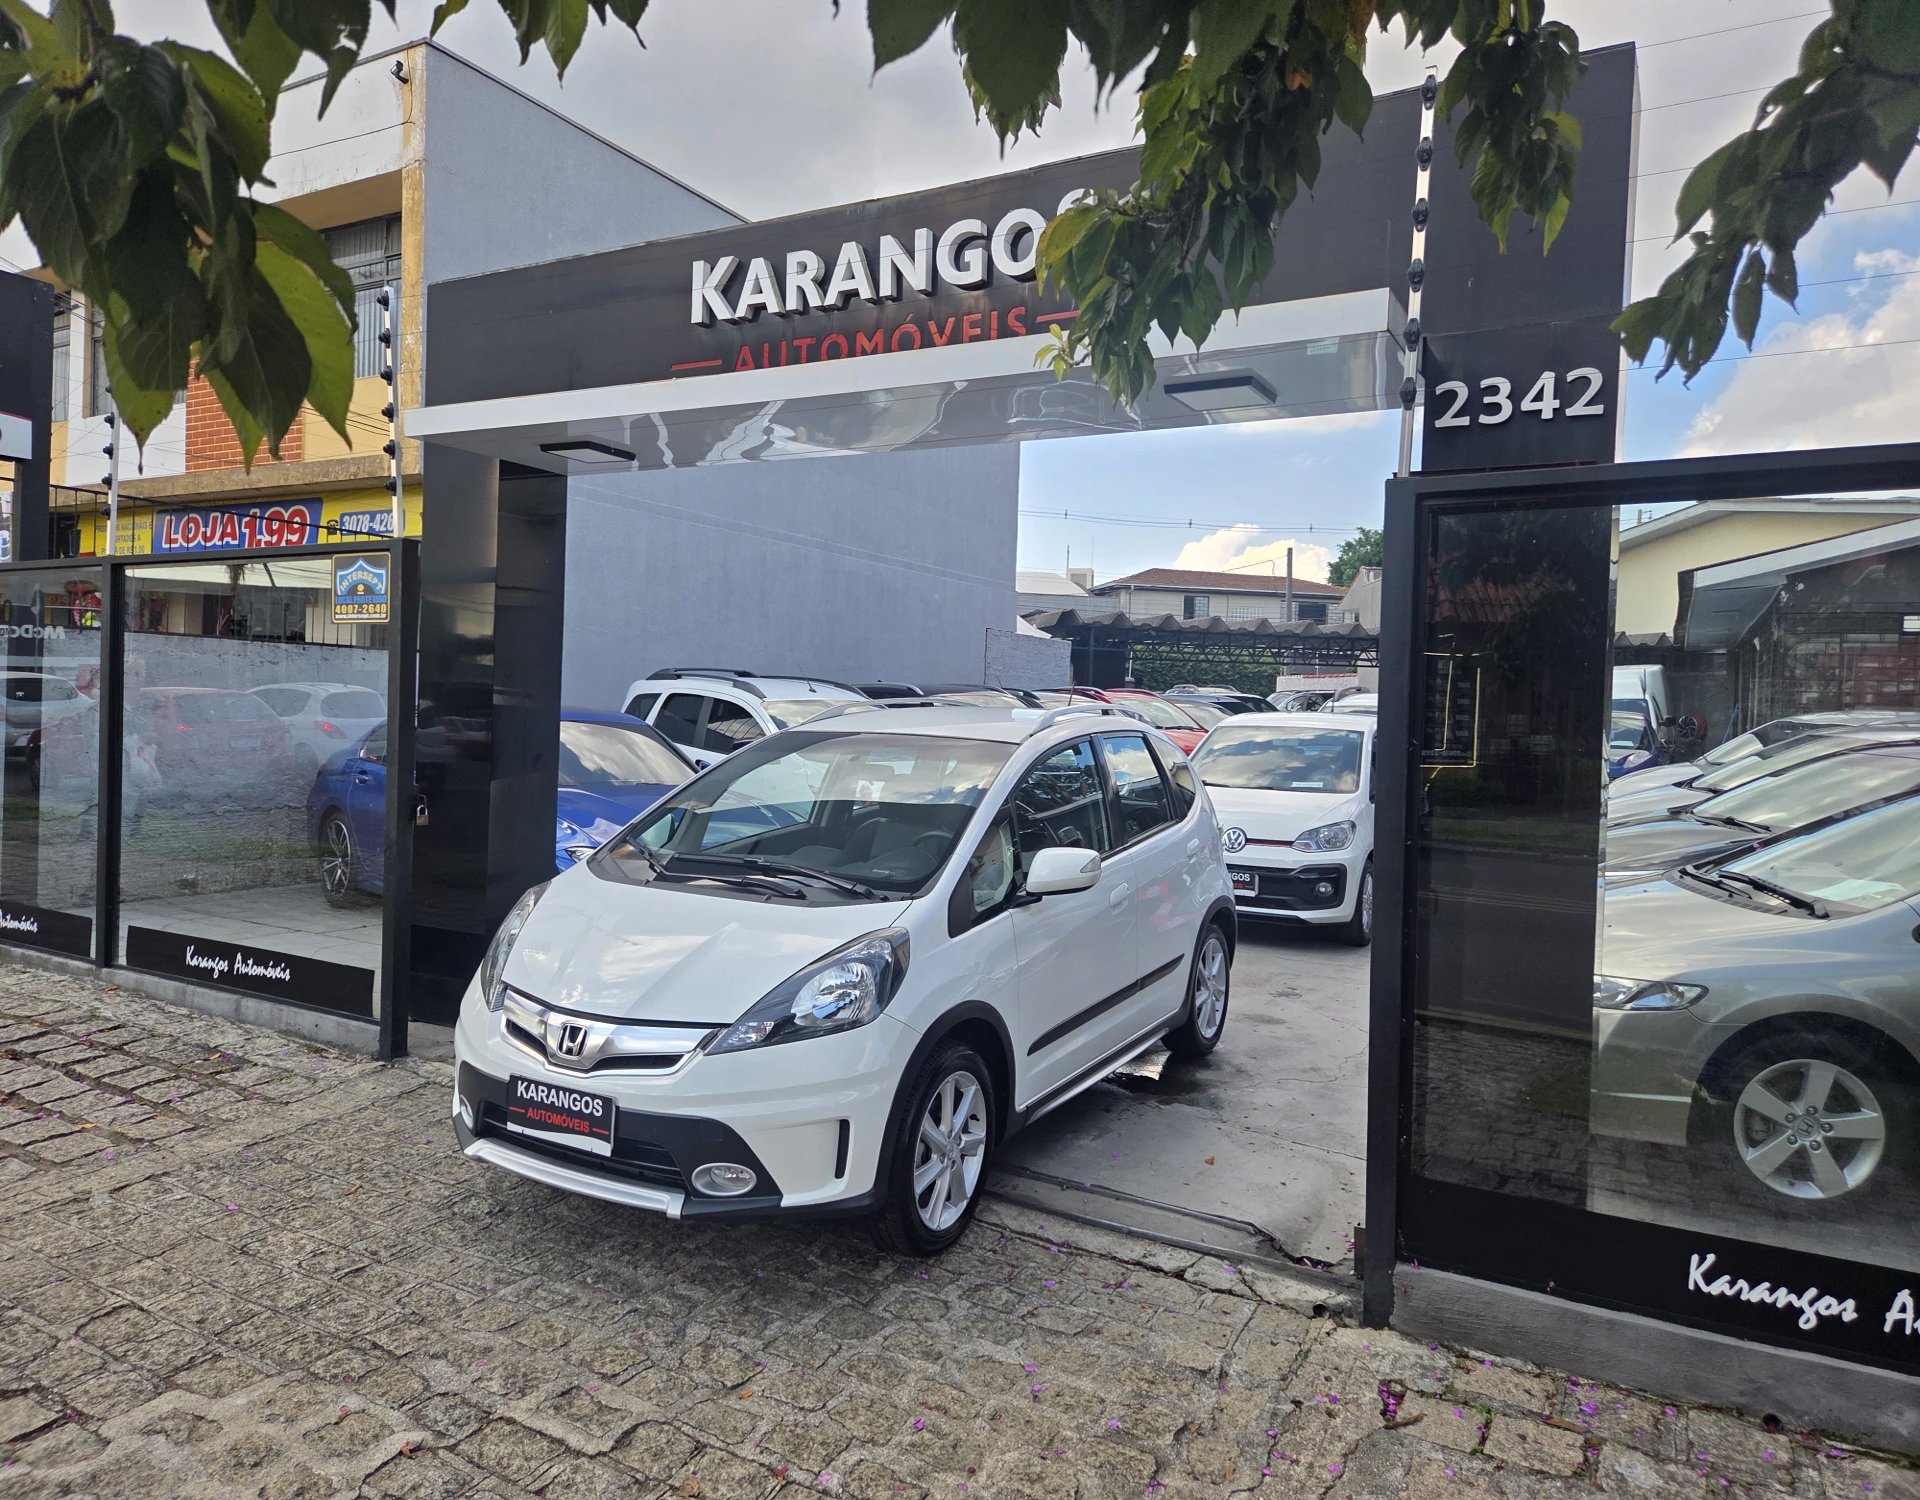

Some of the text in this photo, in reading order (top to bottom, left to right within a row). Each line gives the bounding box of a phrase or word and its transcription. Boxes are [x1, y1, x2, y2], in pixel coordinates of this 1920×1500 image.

[1434, 367, 1604, 428] 2342
[162, 511, 239, 548] LOJA
[342, 512, 395, 535] 3078-426
[340, 571, 383, 592] INTERSEPT
[335, 604, 387, 614] 4007-2640
[186, 945, 291, 981] Karangos Automóveis
[517, 1080, 603, 1117] KARANGOS
[527, 1107, 590, 1133] AUTOMÓVEIS
[1688, 1253, 1920, 1335] Karangos A
